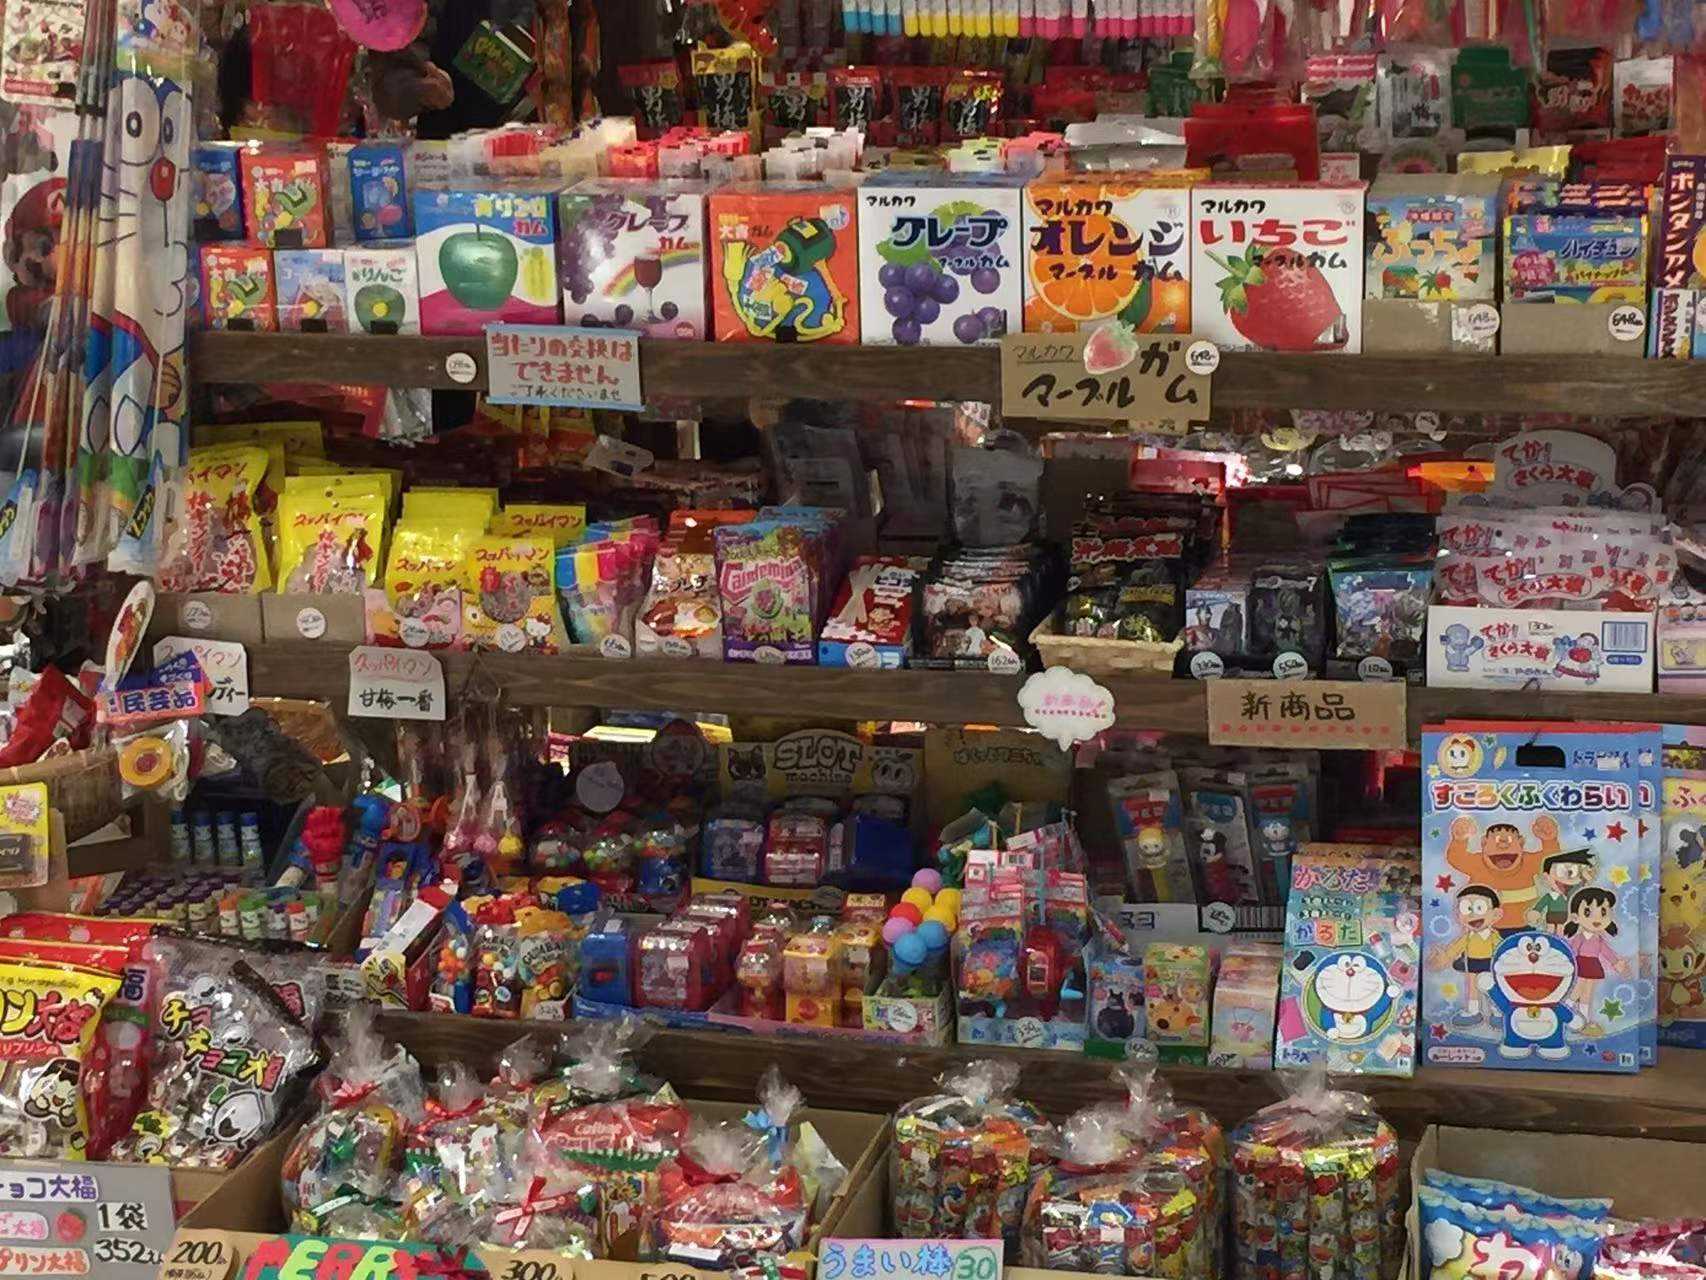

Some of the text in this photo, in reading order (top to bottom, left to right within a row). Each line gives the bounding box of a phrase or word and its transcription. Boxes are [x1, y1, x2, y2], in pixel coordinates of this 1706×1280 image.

[1034, 198, 1113, 217] マルカワ
[1200, 199, 1266, 215] マルカワ
[890, 215, 1009, 248] グレープ
[1029, 220, 1185, 257] オレンジ
[1198, 218, 1356, 247] いちご
[1241, 689, 1356, 722] 新商品
[774, 736, 864, 773] SLOT
[785, 768, 853, 784] machine
[1432, 780, 1631, 809] すごろくふくわらい
[1296, 924, 1357, 940] かるた
[0, 1175, 97, 1200] ョコ大福
[822, 1242, 953, 1279] うまい棒
[956, 1250, 995, 1279] 30
